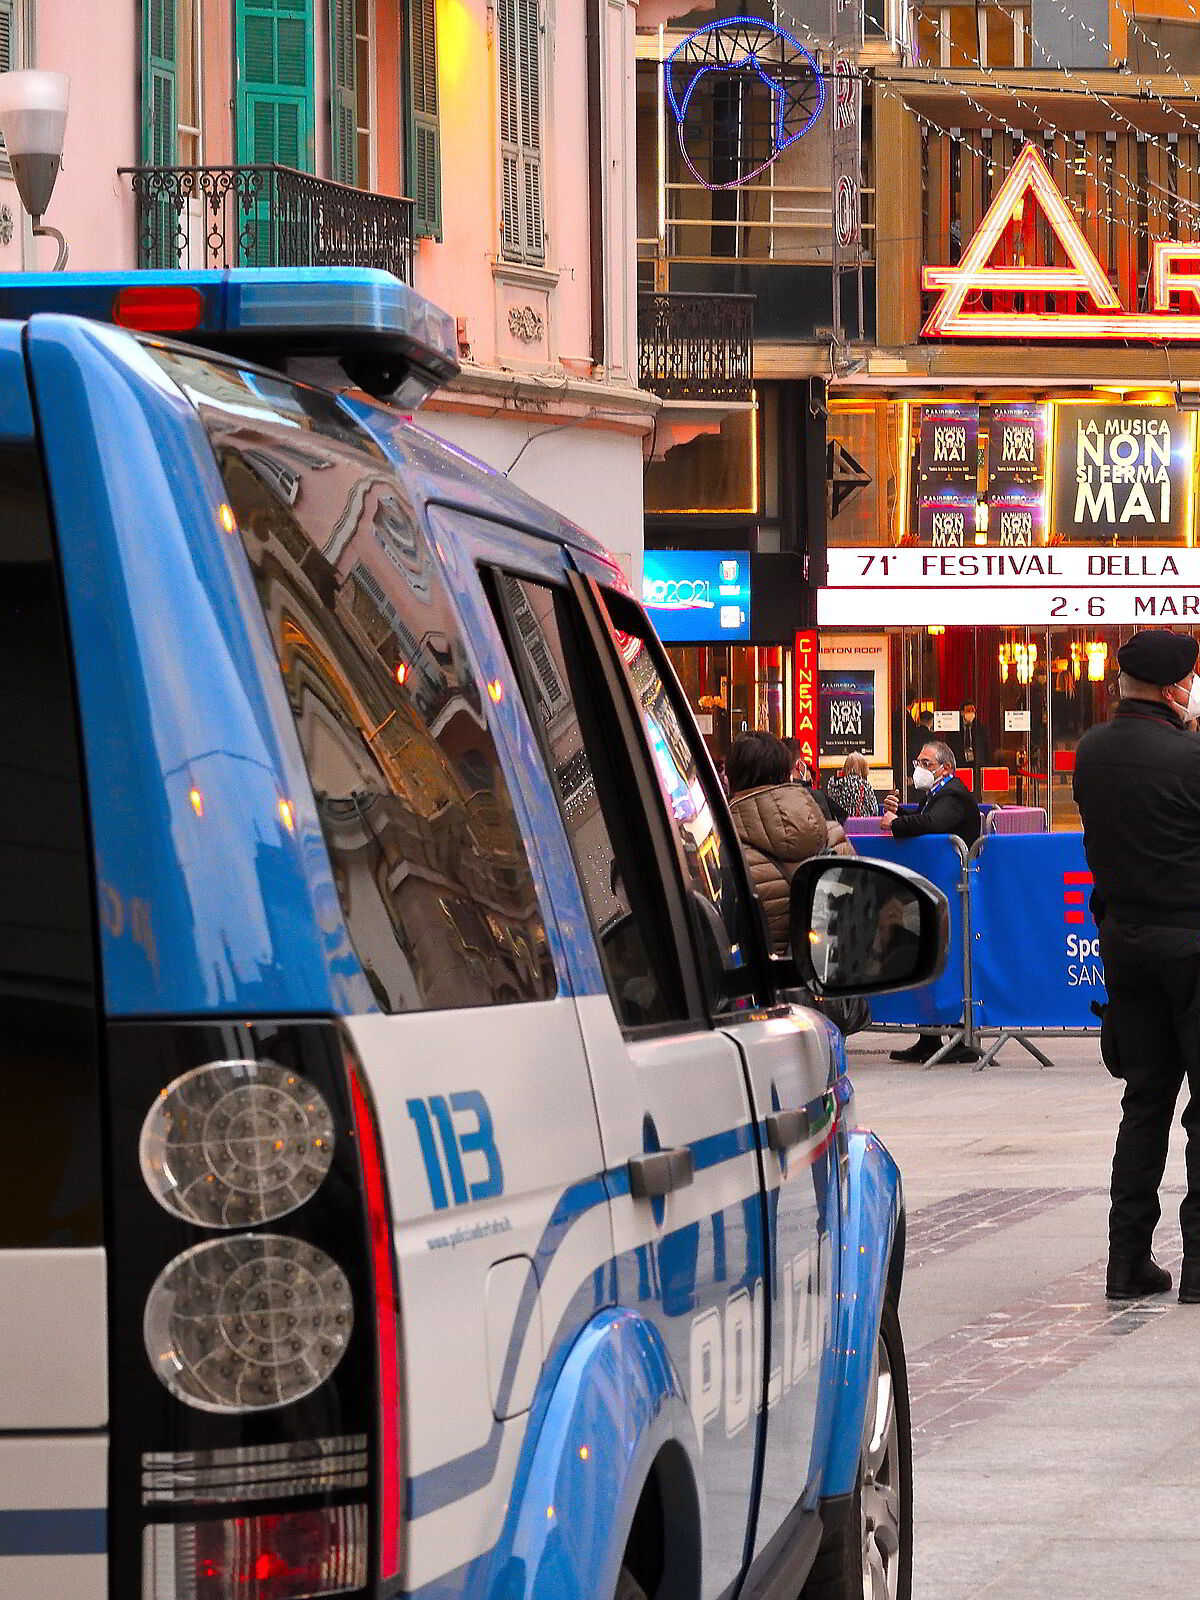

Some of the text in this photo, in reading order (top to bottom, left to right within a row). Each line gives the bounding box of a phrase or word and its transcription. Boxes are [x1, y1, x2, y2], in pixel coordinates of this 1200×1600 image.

[1077, 419, 1170, 435] LA MUSICA
[935, 430, 965, 443] NON
[1003, 430, 1034, 443] NON
[934, 446, 965, 461] MAI
[1002, 446, 1034, 461] MAI
[1077, 432, 1171, 466] NON
[1076, 465, 1170, 484] SI FERMA
[1074, 482, 1170, 523] MAI
[933, 517, 964, 529] NON
[1000, 517, 1032, 529] NON
[932, 533, 964, 547] MAI
[1000, 533, 1032, 547] MAI
[922, 555, 1062, 576] FESTIVAL
[1088, 555, 1179, 576] DELLA
[799, 638, 813, 731] CINEMA
[831, 703, 861, 716] NON
[406, 1090, 504, 1211] 113
